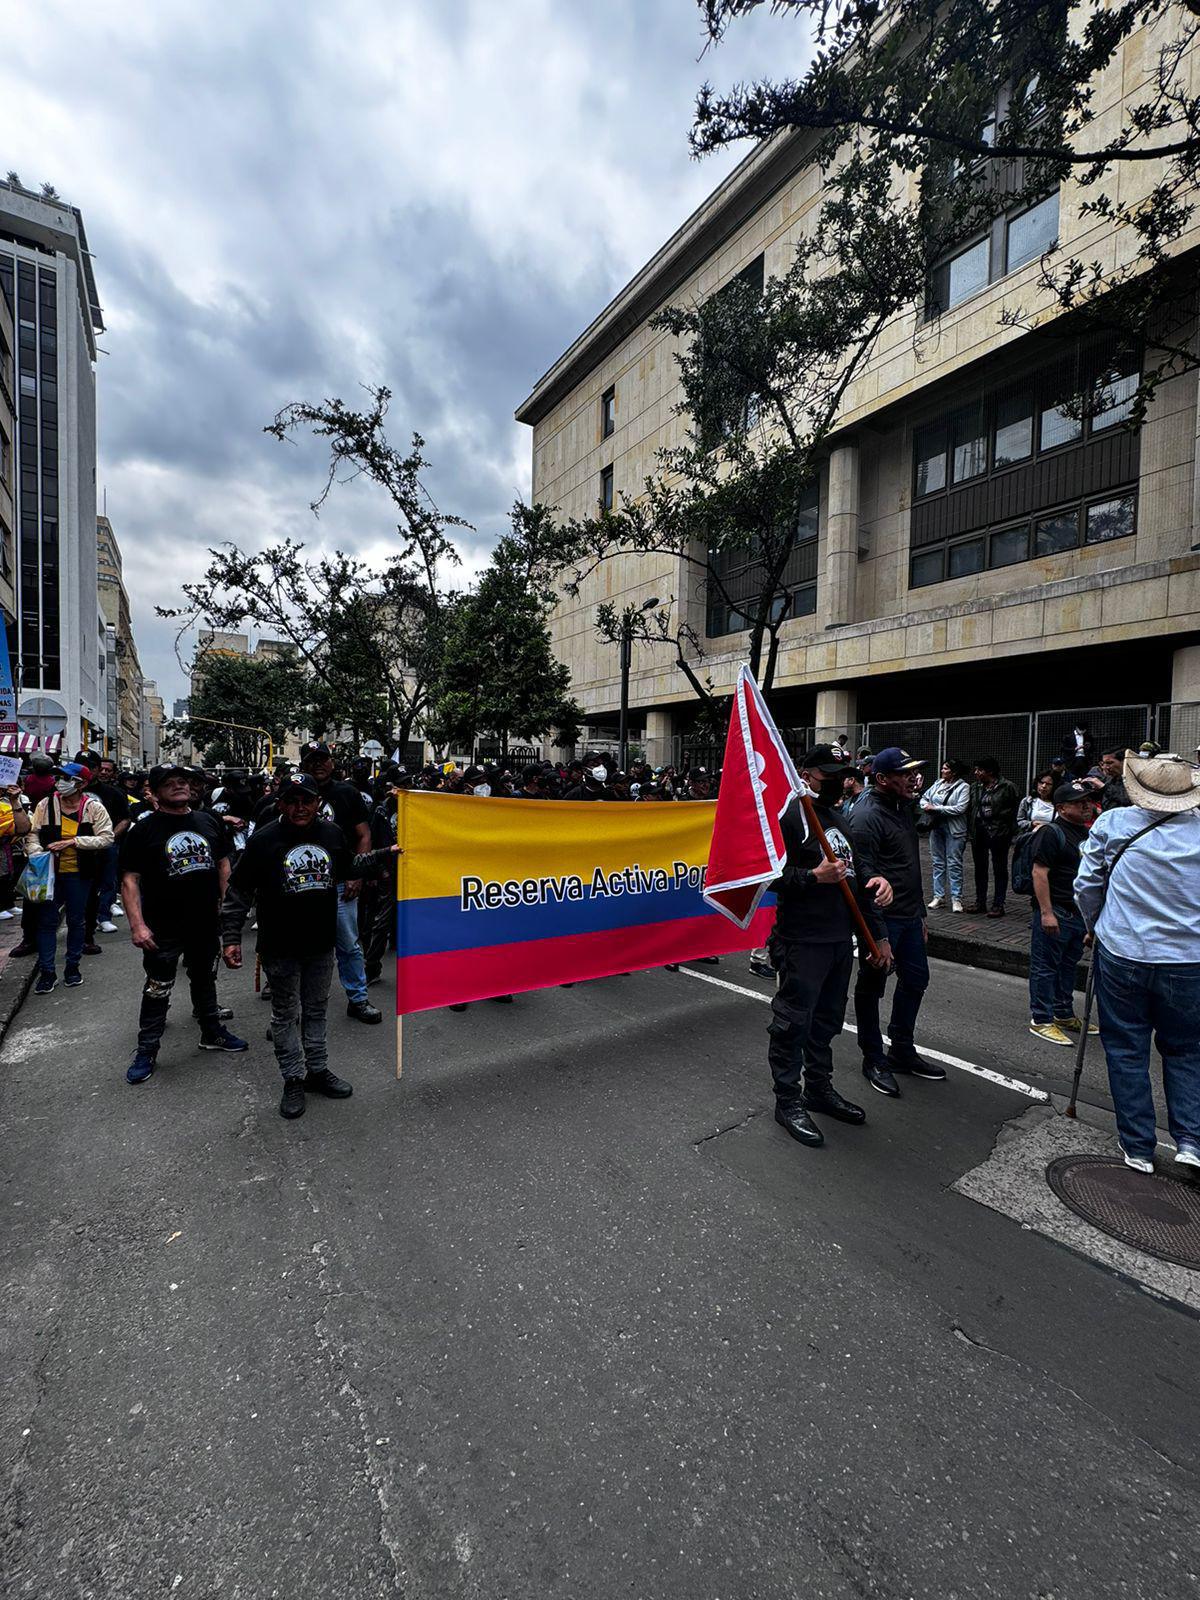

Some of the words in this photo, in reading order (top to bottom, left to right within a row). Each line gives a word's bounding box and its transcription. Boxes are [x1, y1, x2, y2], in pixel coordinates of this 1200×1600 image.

[299, 874, 321, 884] RAP
[461, 875, 583, 911] Reserva
[590, 863, 669, 899] Activa
